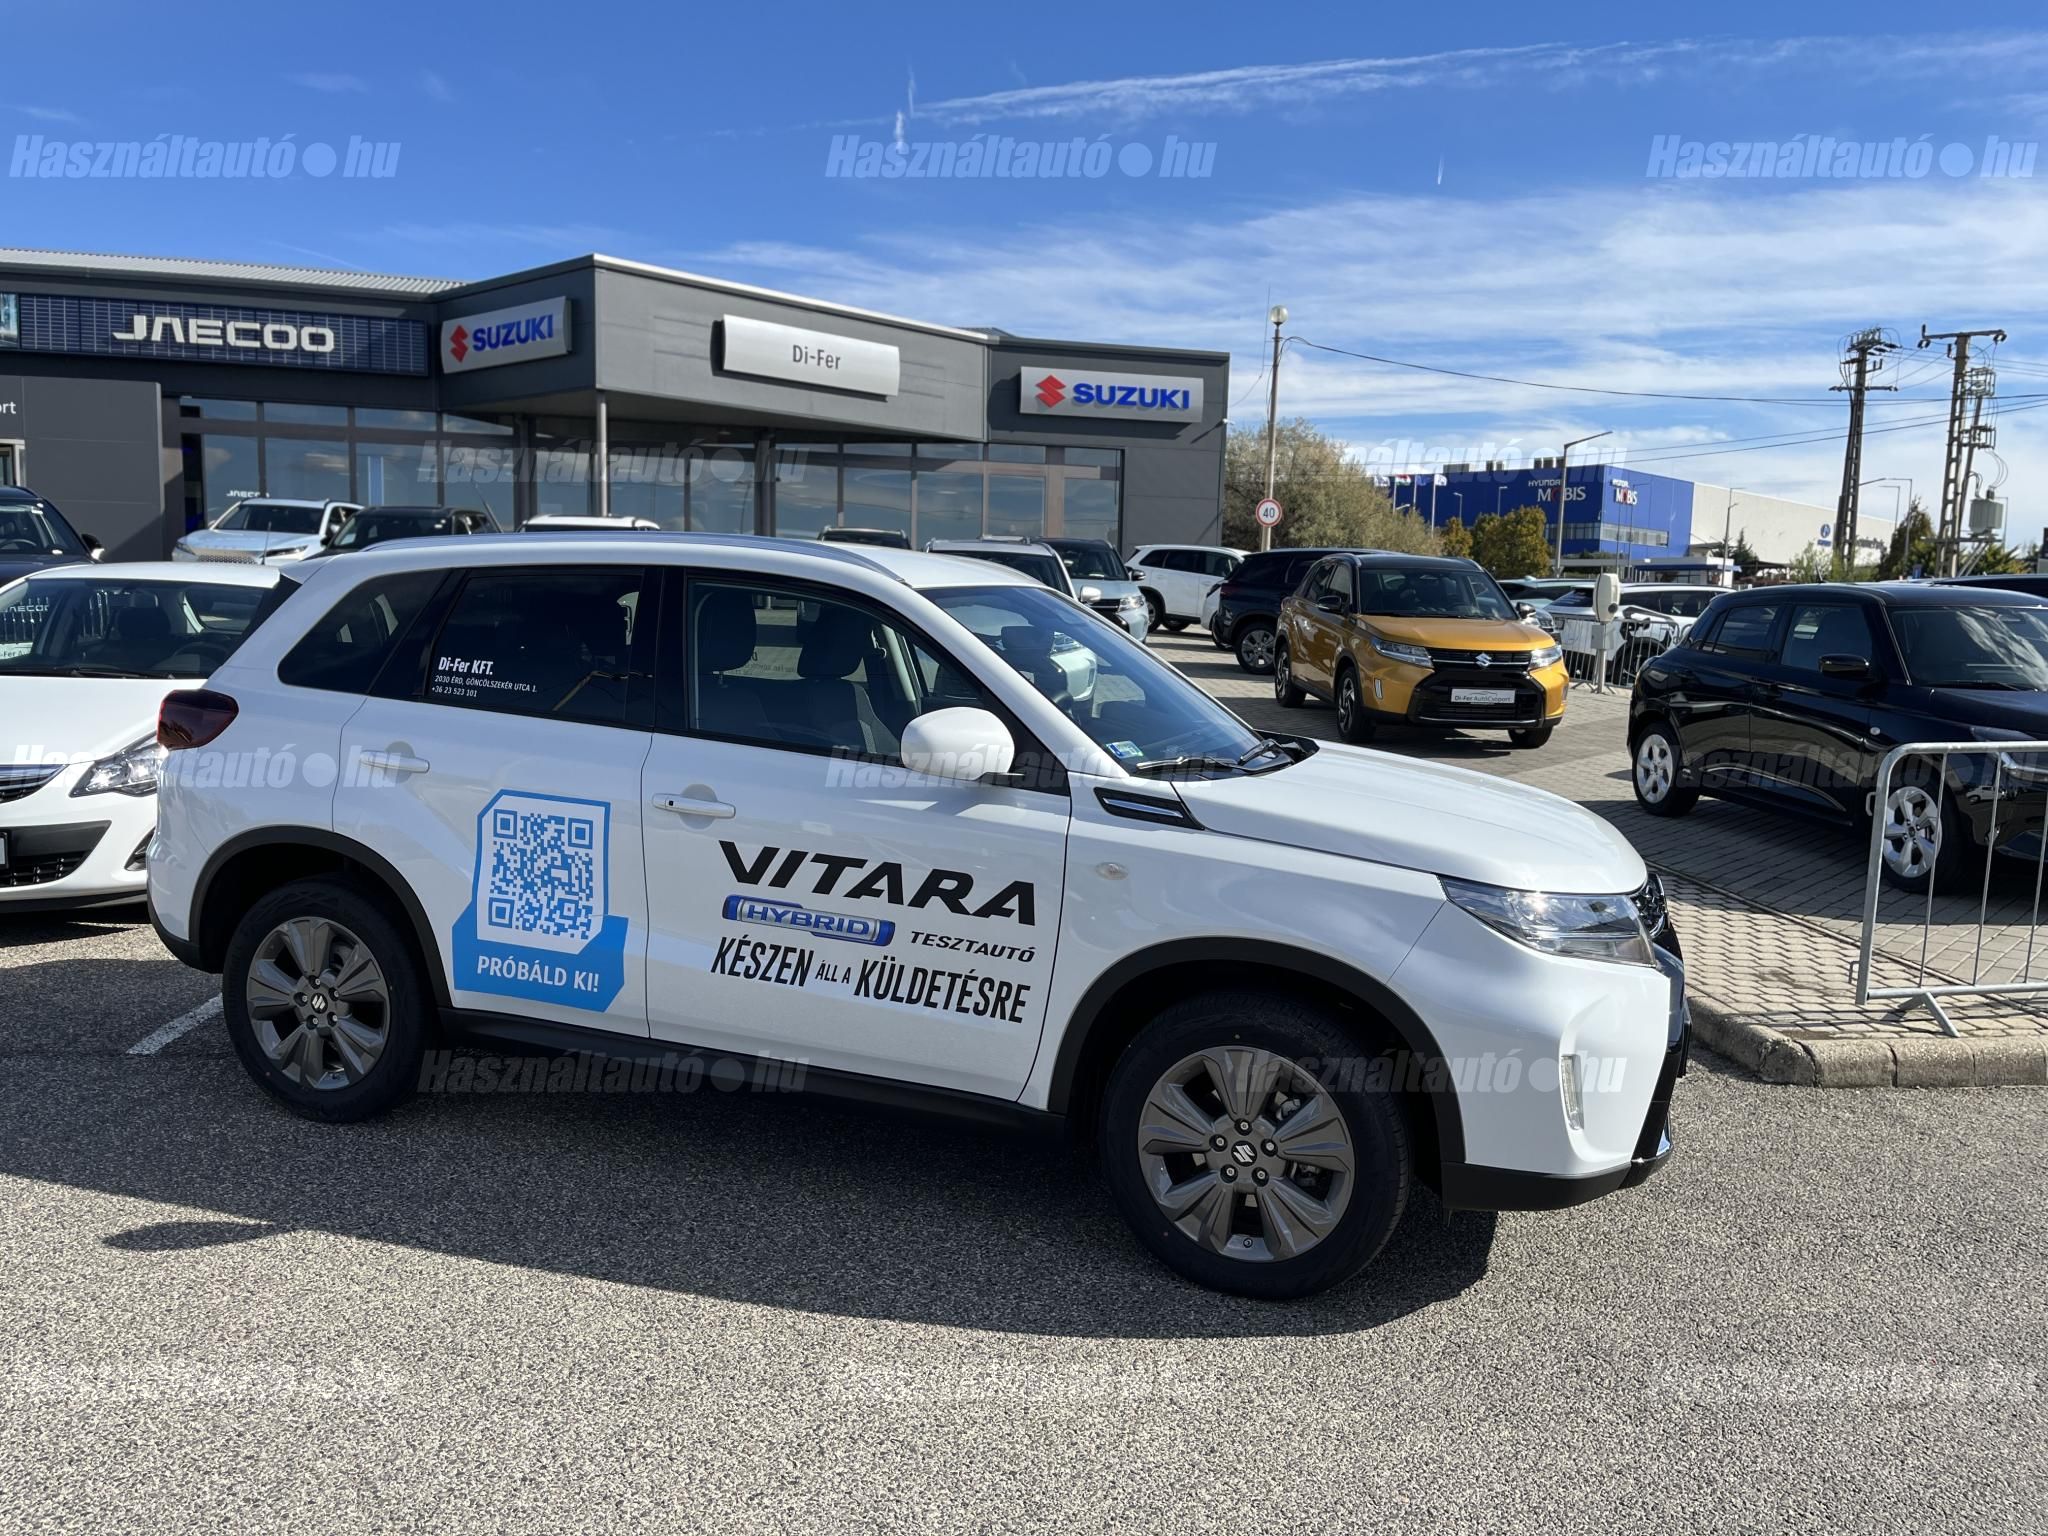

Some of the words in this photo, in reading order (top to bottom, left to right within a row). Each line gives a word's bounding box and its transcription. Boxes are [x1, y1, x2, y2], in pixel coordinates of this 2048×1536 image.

[112, 314, 335, 352] JAECOO
[472, 314, 553, 352] SUZUKI
[793, 344, 841, 370] Di-Fer
[1072, 383, 1190, 410] SUZUKI
[1263, 507, 1276, 519] 40
[437, 656, 471, 673] Di-Fer
[471, 659, 494, 675] KFT.
[431, 685, 443, 693] +36
[443, 686, 452, 694] 23
[452, 687, 465, 695] 523
[466, 689, 478, 697] 101
[434, 675, 450, 683] 2030
[513, 683, 531, 692] UTCA
[718, 839, 1036, 926] VITARA
[746, 904, 870, 935] HYBRID
[910, 930, 1037, 963] TESZTAUTÓ
[476, 955, 567, 987] PRÓBÁLD
[573, 970, 600, 993] KI!
[710, 934, 814, 987] KÉSZEN
[815, 959, 839, 984] ÁLL
[840, 966, 852, 985] A
[854, 955, 1031, 1024] KÜLDETÉSRE
